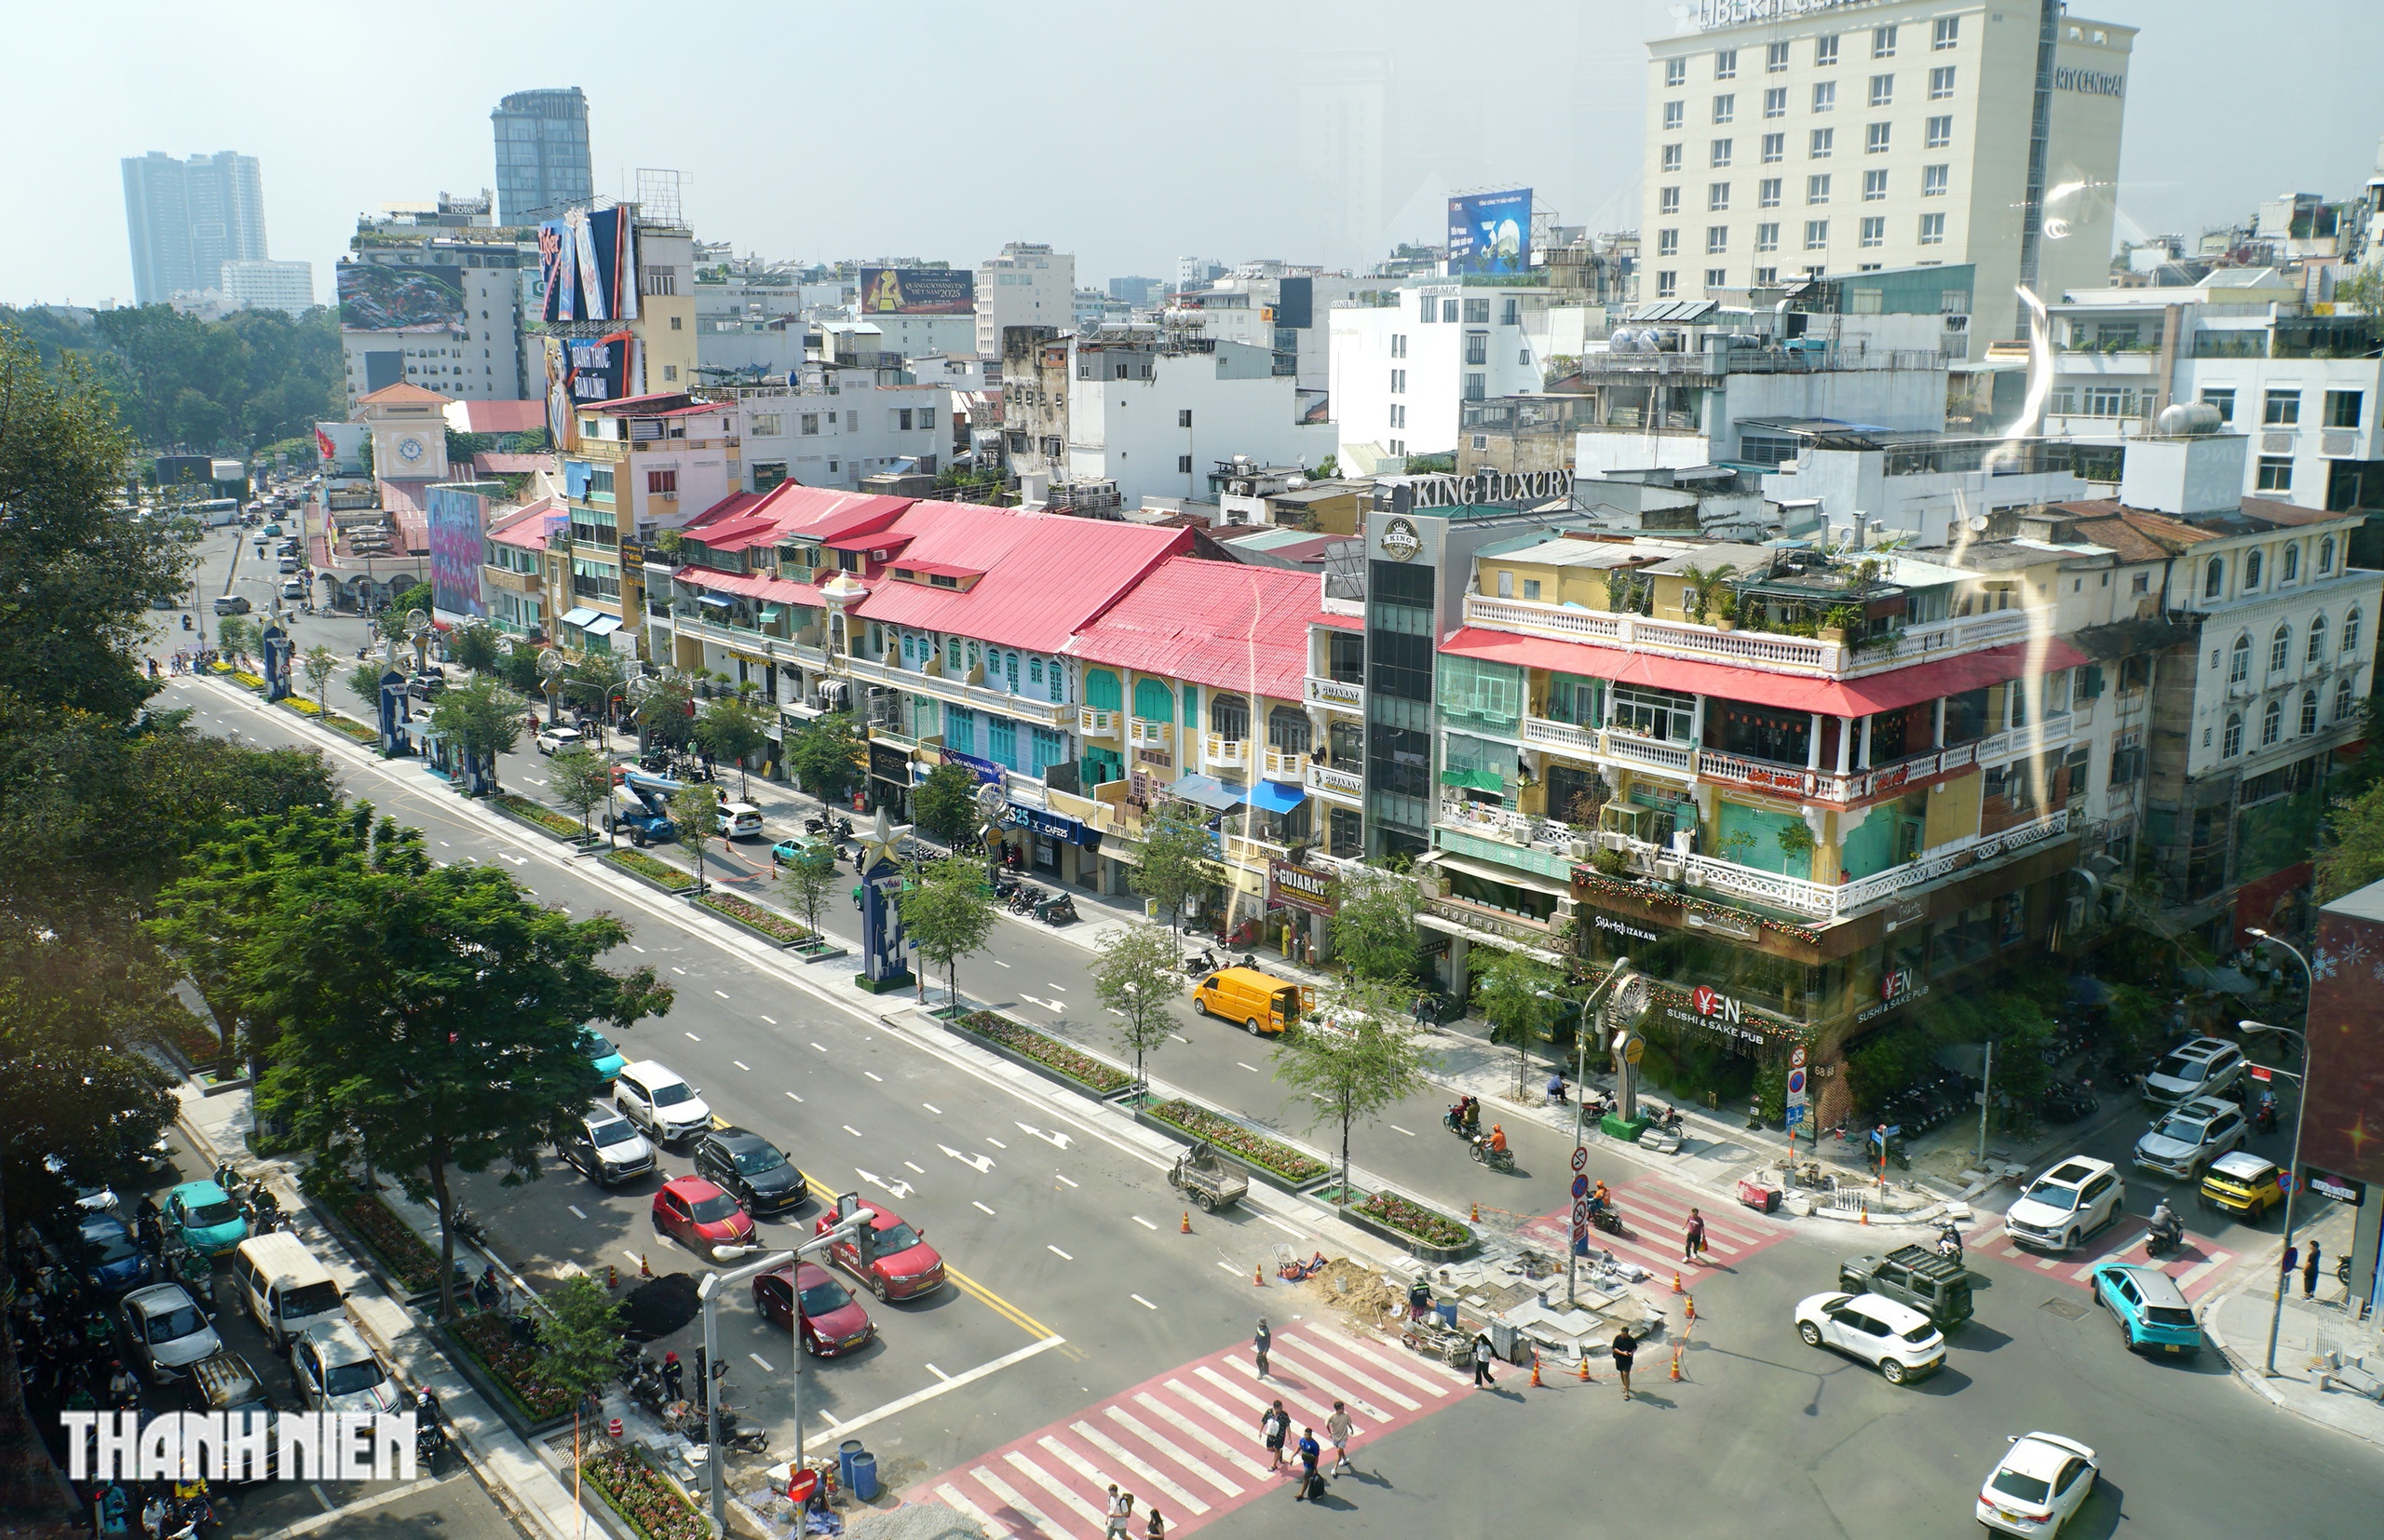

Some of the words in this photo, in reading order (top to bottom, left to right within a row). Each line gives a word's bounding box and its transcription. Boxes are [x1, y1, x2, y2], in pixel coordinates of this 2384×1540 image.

[2078, 70, 2123, 98] CENTRAL
[451, 205, 477, 214] hotel
[457, 226, 518, 236] SILVERLAND
[538, 226, 561, 265] Tiger
[940, 289, 961, 298] 2025
[1414, 475, 1478, 508] KING
[1484, 467, 1577, 503] LUXURY
[1389, 534, 1412, 544] KING
[1321, 685, 1360, 700] GUJARAT
[1324, 774, 1361, 790] GUJARAT
[1044, 824, 1068, 839] CAFE25
[1279, 869, 1326, 896] GUJARAT
[1280, 884, 1296, 894] INDIAN
[1295, 888, 1327, 903] RESTAURANT
[1626, 927, 1657, 942] IZAKAYA
[1858, 1006, 1882, 1024] SUSHI
[1890, 993, 1912, 1009] SAKE
[1912, 985, 1930, 1000] PUB
[1667, 1007, 1699, 1024] SUSHI
[1700, 1018, 1707, 1027] &
[1708, 1020, 1739, 1037] SAKE
[1741, 1030, 1764, 1045] PUB
[1814, 1065, 1825, 1077] 68
[1826, 1065, 1835, 1077] 68
[2312, 1180, 2334, 1194] HOA
